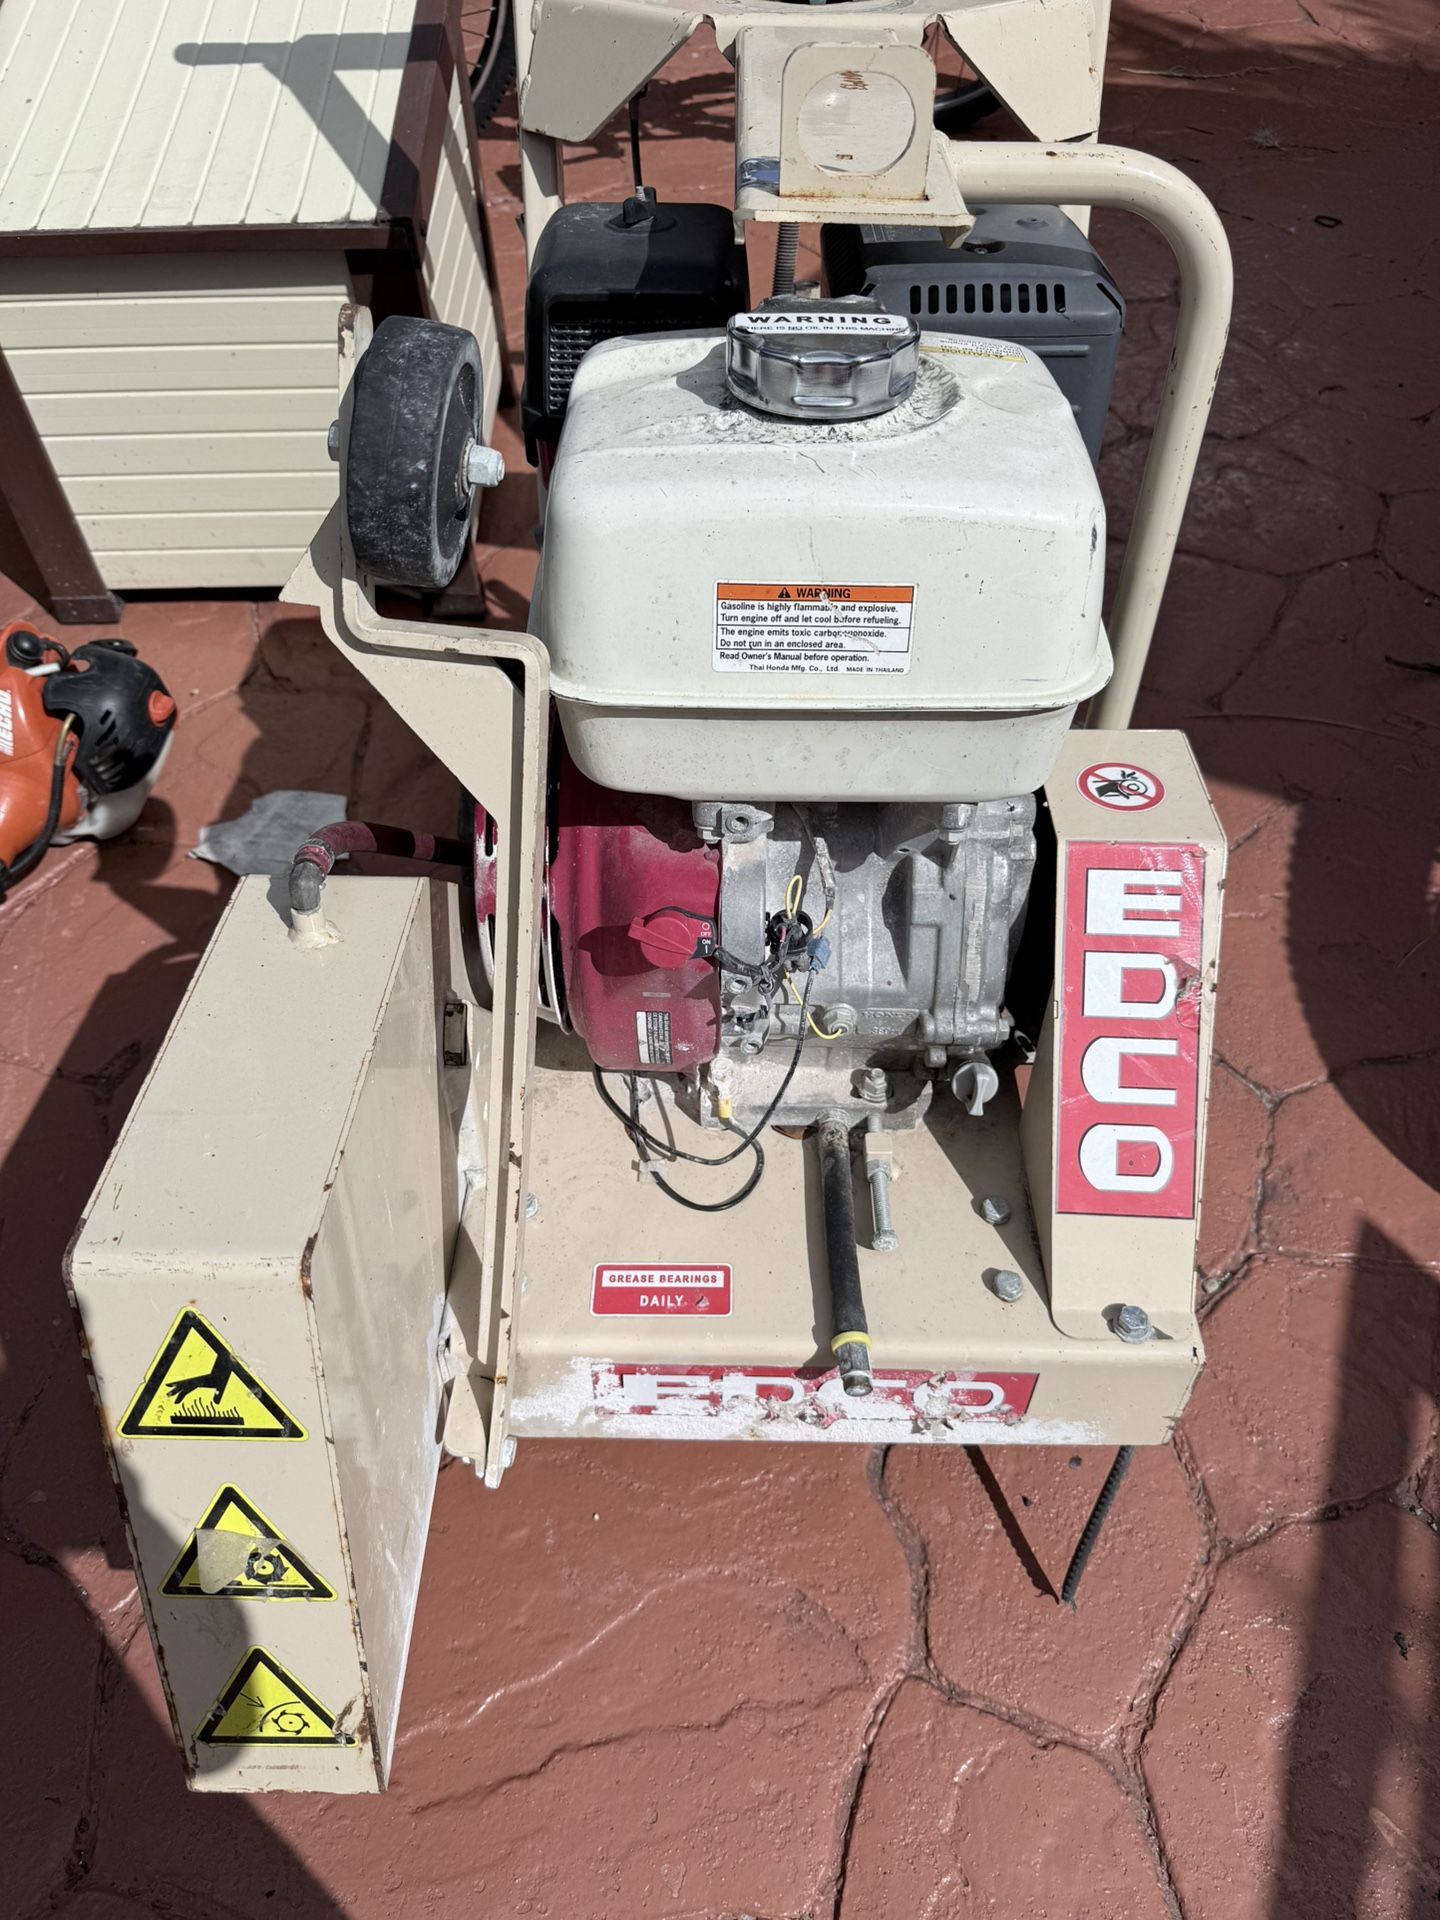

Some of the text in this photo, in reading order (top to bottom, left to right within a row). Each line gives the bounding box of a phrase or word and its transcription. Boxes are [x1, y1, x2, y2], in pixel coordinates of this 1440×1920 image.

[748, 316, 891, 325] WARNING
[796, 587, 851, 599] WARNING
[720, 601, 898, 613] Gasoline is highly flammabe and explosive.
[720, 613, 738, 622] Turn
[741, 614, 768, 624] engine
[770, 614, 782, 622] off
[784, 614, 799, 623] and
[801, 615, 812, 623] let
[814, 615, 831, 623] cool
[863, 616, 901, 626] refueling.
[720, 627, 735, 636] The
[738, 628, 765, 637] engine
[767, 628, 789, 636] emits
[792, 628, 811, 637] toxic
[720, 639, 731, 647] Do
[733, 639, 746, 647] not
[749, 641, 762, 650] run
[765, 639, 772, 647] in
[787, 640, 823, 648] enclosed
[719, 651, 869, 663] Read Owner's Manual before operation.
[1078, 868, 1183, 1193] EDCO
[608, 1274, 718, 1283] GREASE BEARINGS
[640, 1295, 684, 1307] DAILY
[622, 1373, 1006, 1416] EDCO
